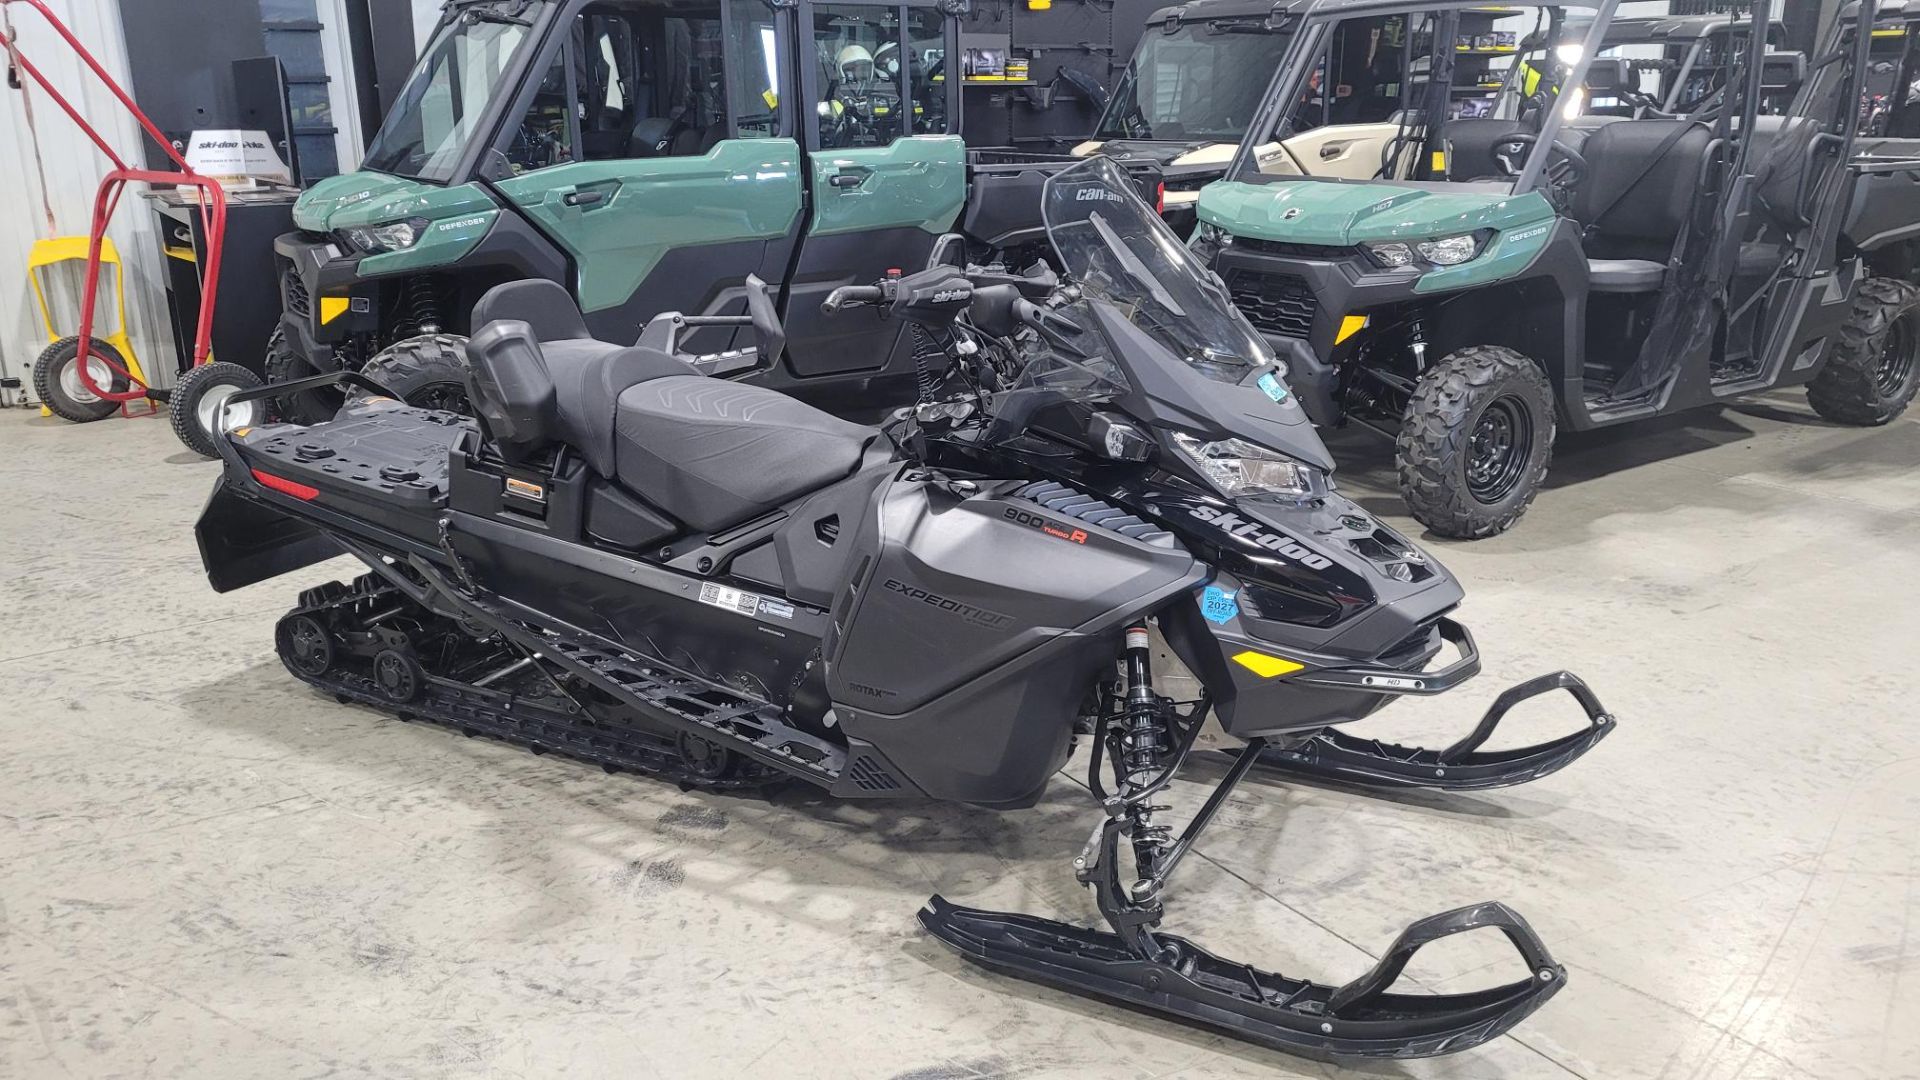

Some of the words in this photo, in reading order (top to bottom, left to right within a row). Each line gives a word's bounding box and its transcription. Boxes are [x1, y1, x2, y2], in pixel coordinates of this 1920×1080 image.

[199, 141, 239, 149] ski-doo
[1076, 188, 1123, 204] can-am
[1372, 200, 1393, 213] HD7
[440, 217, 485, 231] DEFENDER
[1509, 227, 1547, 243] DEFENDER
[932, 289, 971, 303] ski-doo
[1004, 507, 1043, 528] 900
[1043, 527, 1070, 539] TURBO
[1070, 530, 1088, 544] R
[1189, 506, 1333, 570] ski-doo
[884, 579, 1016, 626] EXPEDITION
[1207, 601, 1234, 611] 2027
[849, 682, 882, 698] ROTAX
